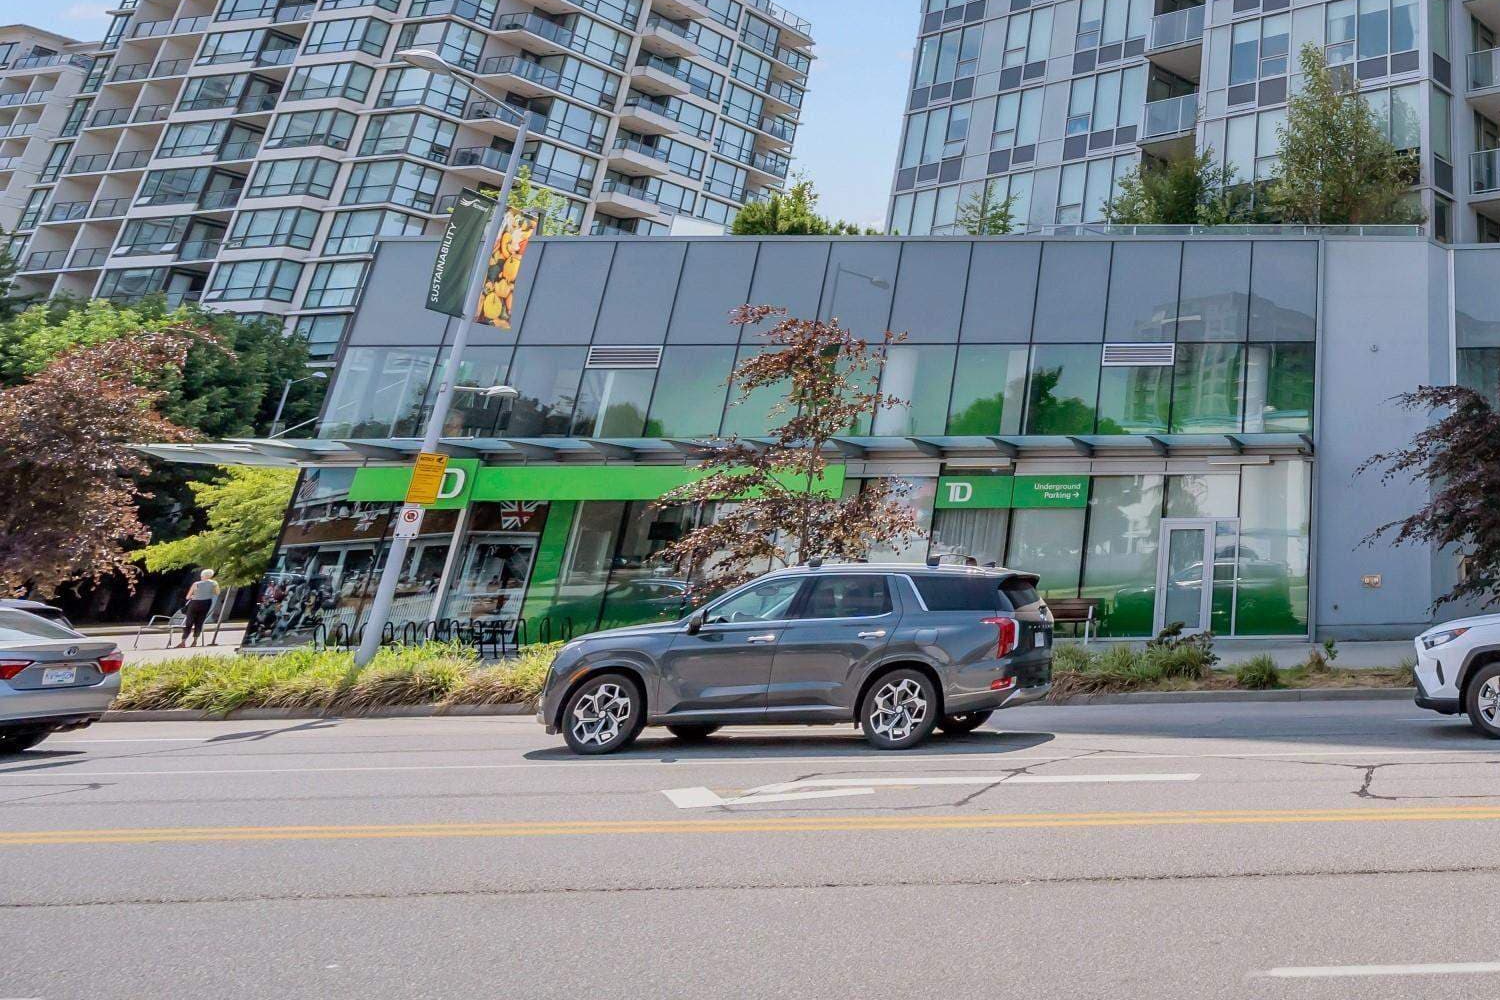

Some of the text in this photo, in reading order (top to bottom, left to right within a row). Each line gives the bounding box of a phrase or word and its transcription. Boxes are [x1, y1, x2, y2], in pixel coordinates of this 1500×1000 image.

[431, 222, 457, 303] SUSTAINABILITY
[437, 468, 466, 499] D
[945, 482, 973, 503] TD
[1044, 491, 1071, 500] Parking
